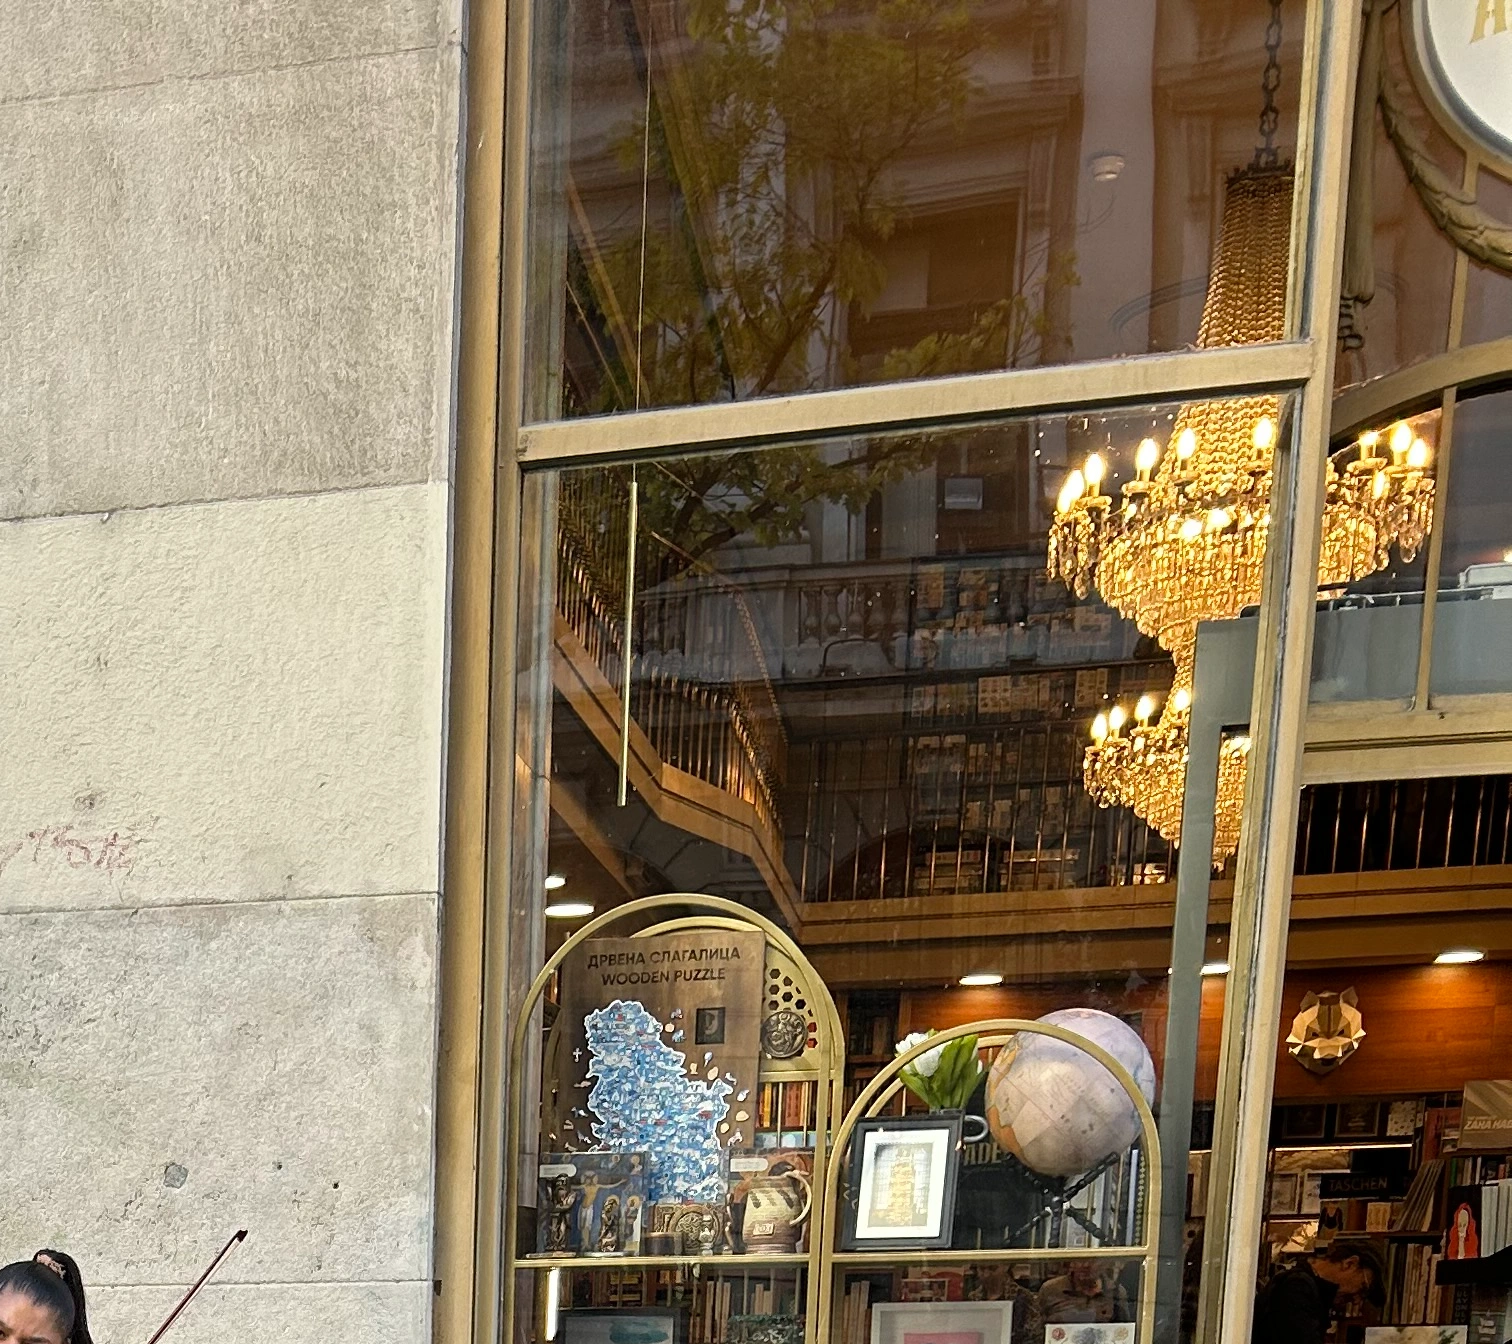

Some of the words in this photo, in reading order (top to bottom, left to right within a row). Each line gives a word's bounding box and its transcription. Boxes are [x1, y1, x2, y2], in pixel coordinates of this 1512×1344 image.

[588, 953, 646, 969] ДРВЕНА
[649, 946, 741, 964] СЛАГАЛИЦА
[601, 970, 670, 986] WOODEN
[673, 967, 726, 983] PUZZLE
[1329, 1177, 1388, 1192] TASCHEN
